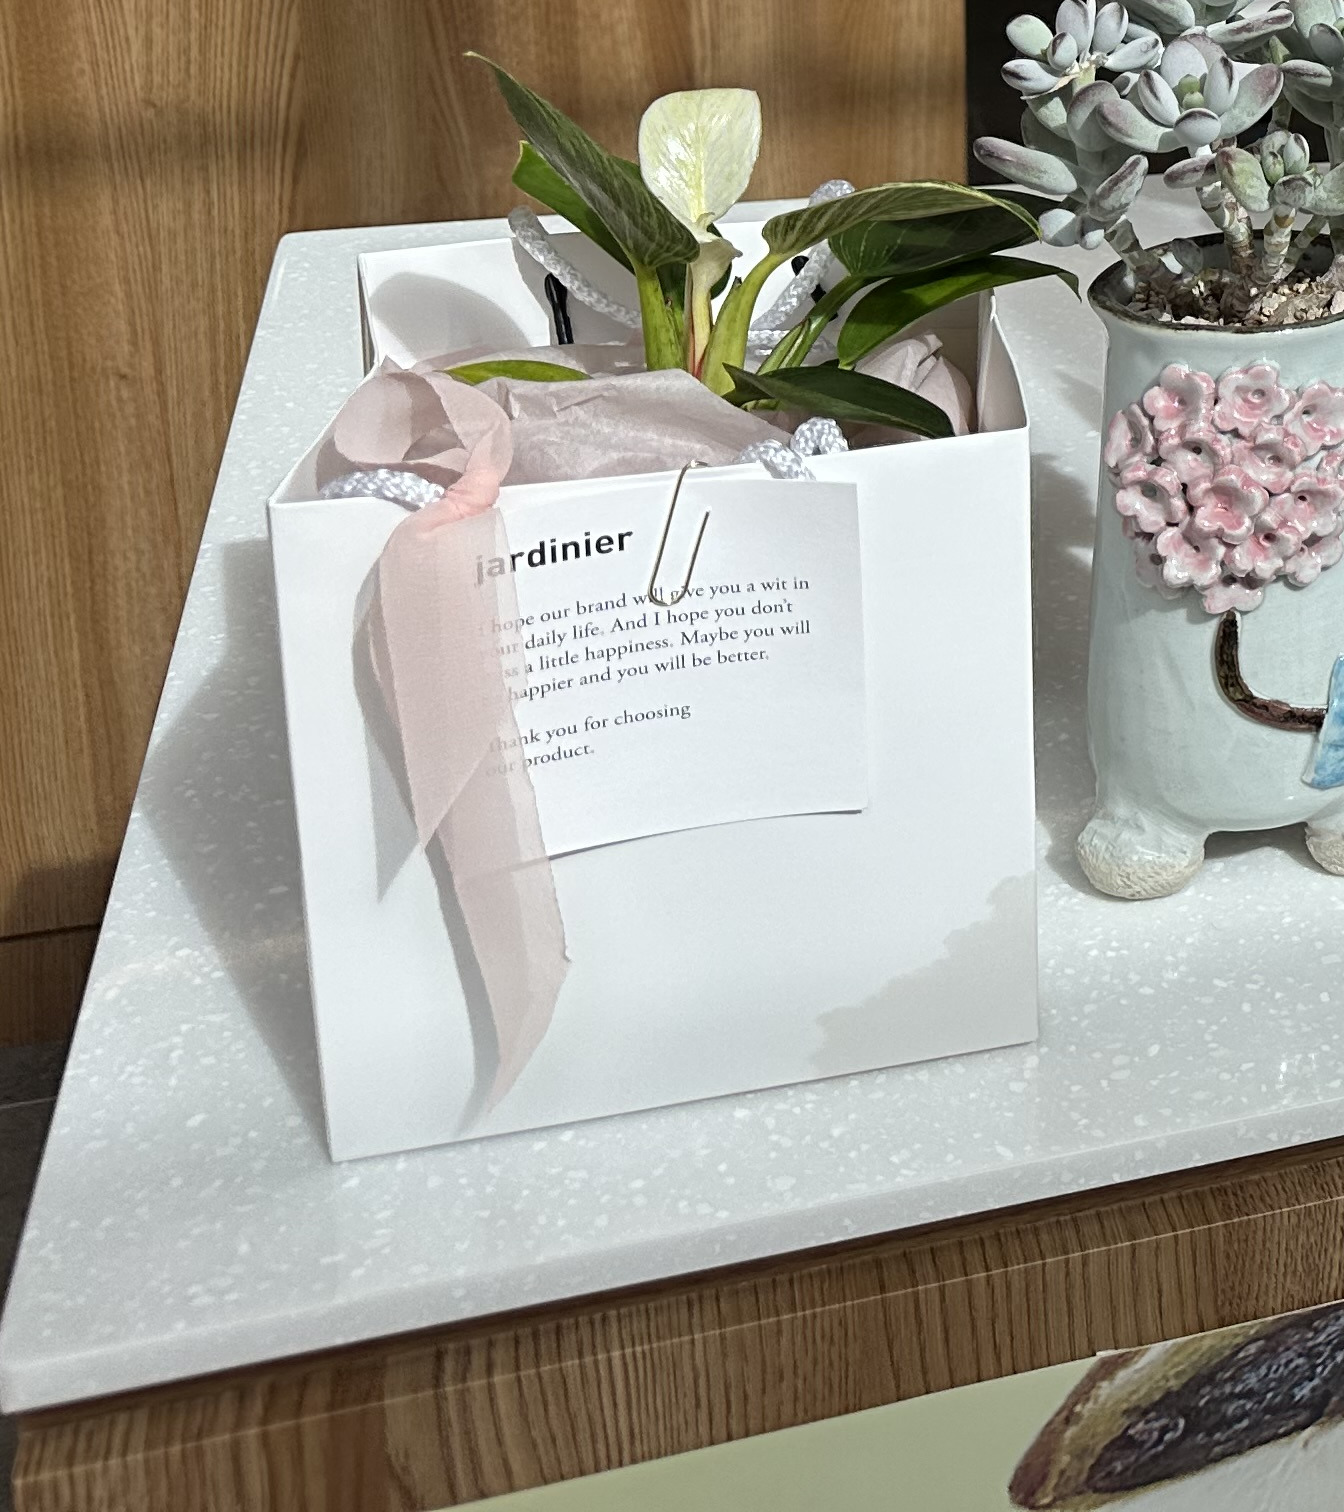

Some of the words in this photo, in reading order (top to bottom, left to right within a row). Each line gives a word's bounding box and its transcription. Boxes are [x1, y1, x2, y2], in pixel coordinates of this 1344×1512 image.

[474, 531, 634, 587] jardinier
[491, 614, 534, 635] hope
[540, 607, 571, 623] our
[576, 592, 627, 616] brand
[632, 586, 663, 606] wll
[709, 583, 741, 600] you
[746, 582, 756, 593] a
[760, 577, 788, 592] wit
[793, 576, 810, 590] in
[525, 629, 567, 650] daily
[572, 621, 604, 640] life.
[610, 613, 647, 632] And
[654, 611, 662, 626] I
[667, 609, 709, 626] hope
[714, 605, 745, 623] you
[751, 598, 793, 616] don't
[525, 663, 533, 674] a
[539, 651, 579, 671] little
[585, 637, 674, 661] happiness.
[680, 626, 739, 646] Maybe
[744, 626, 775, 644] you
[780, 619, 811, 636] will
[508, 676, 574, 702] happier
[579, 666, 612, 686] and
[617, 663, 649, 684] you
[655, 653, 686, 673] will
[692, 652, 712, 669] be
[717, 648, 769, 665] better.
[546, 723, 578, 744] you
[584, 715, 609, 732] for
[614, 702, 691, 726] choosing
[524, 744, 595, 768] product.
